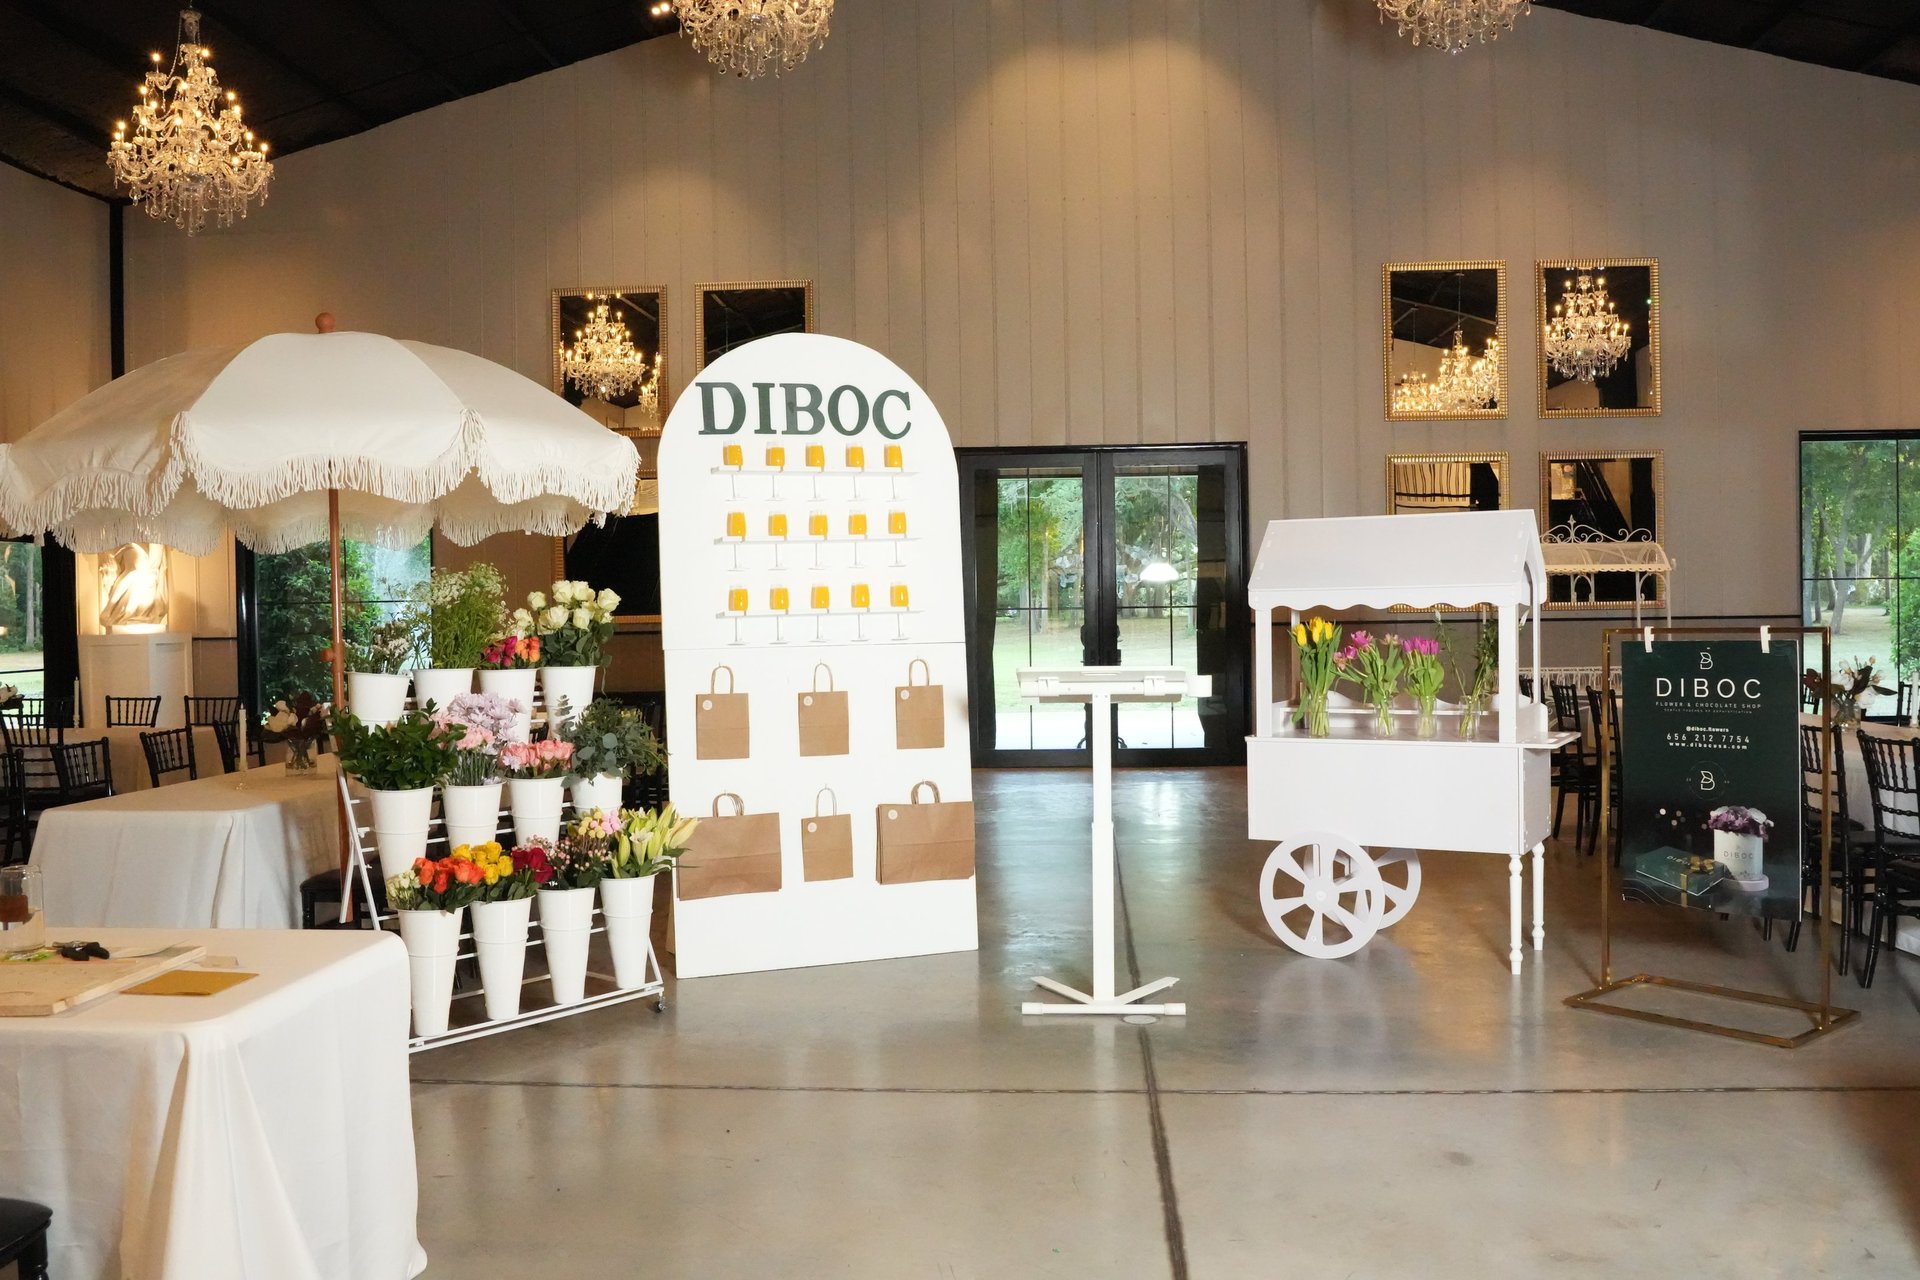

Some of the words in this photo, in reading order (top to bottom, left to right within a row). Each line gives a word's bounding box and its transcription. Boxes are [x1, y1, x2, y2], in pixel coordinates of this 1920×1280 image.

[695, 382, 911, 440] DIBOC
[1656, 677, 1761, 698] DIBOC
[1666, 733, 1687, 741] 656
[1694, 734, 1714, 742] 212
[1722, 735, 1750, 743] 7754
[1723, 850, 1754, 859] DIBOC
